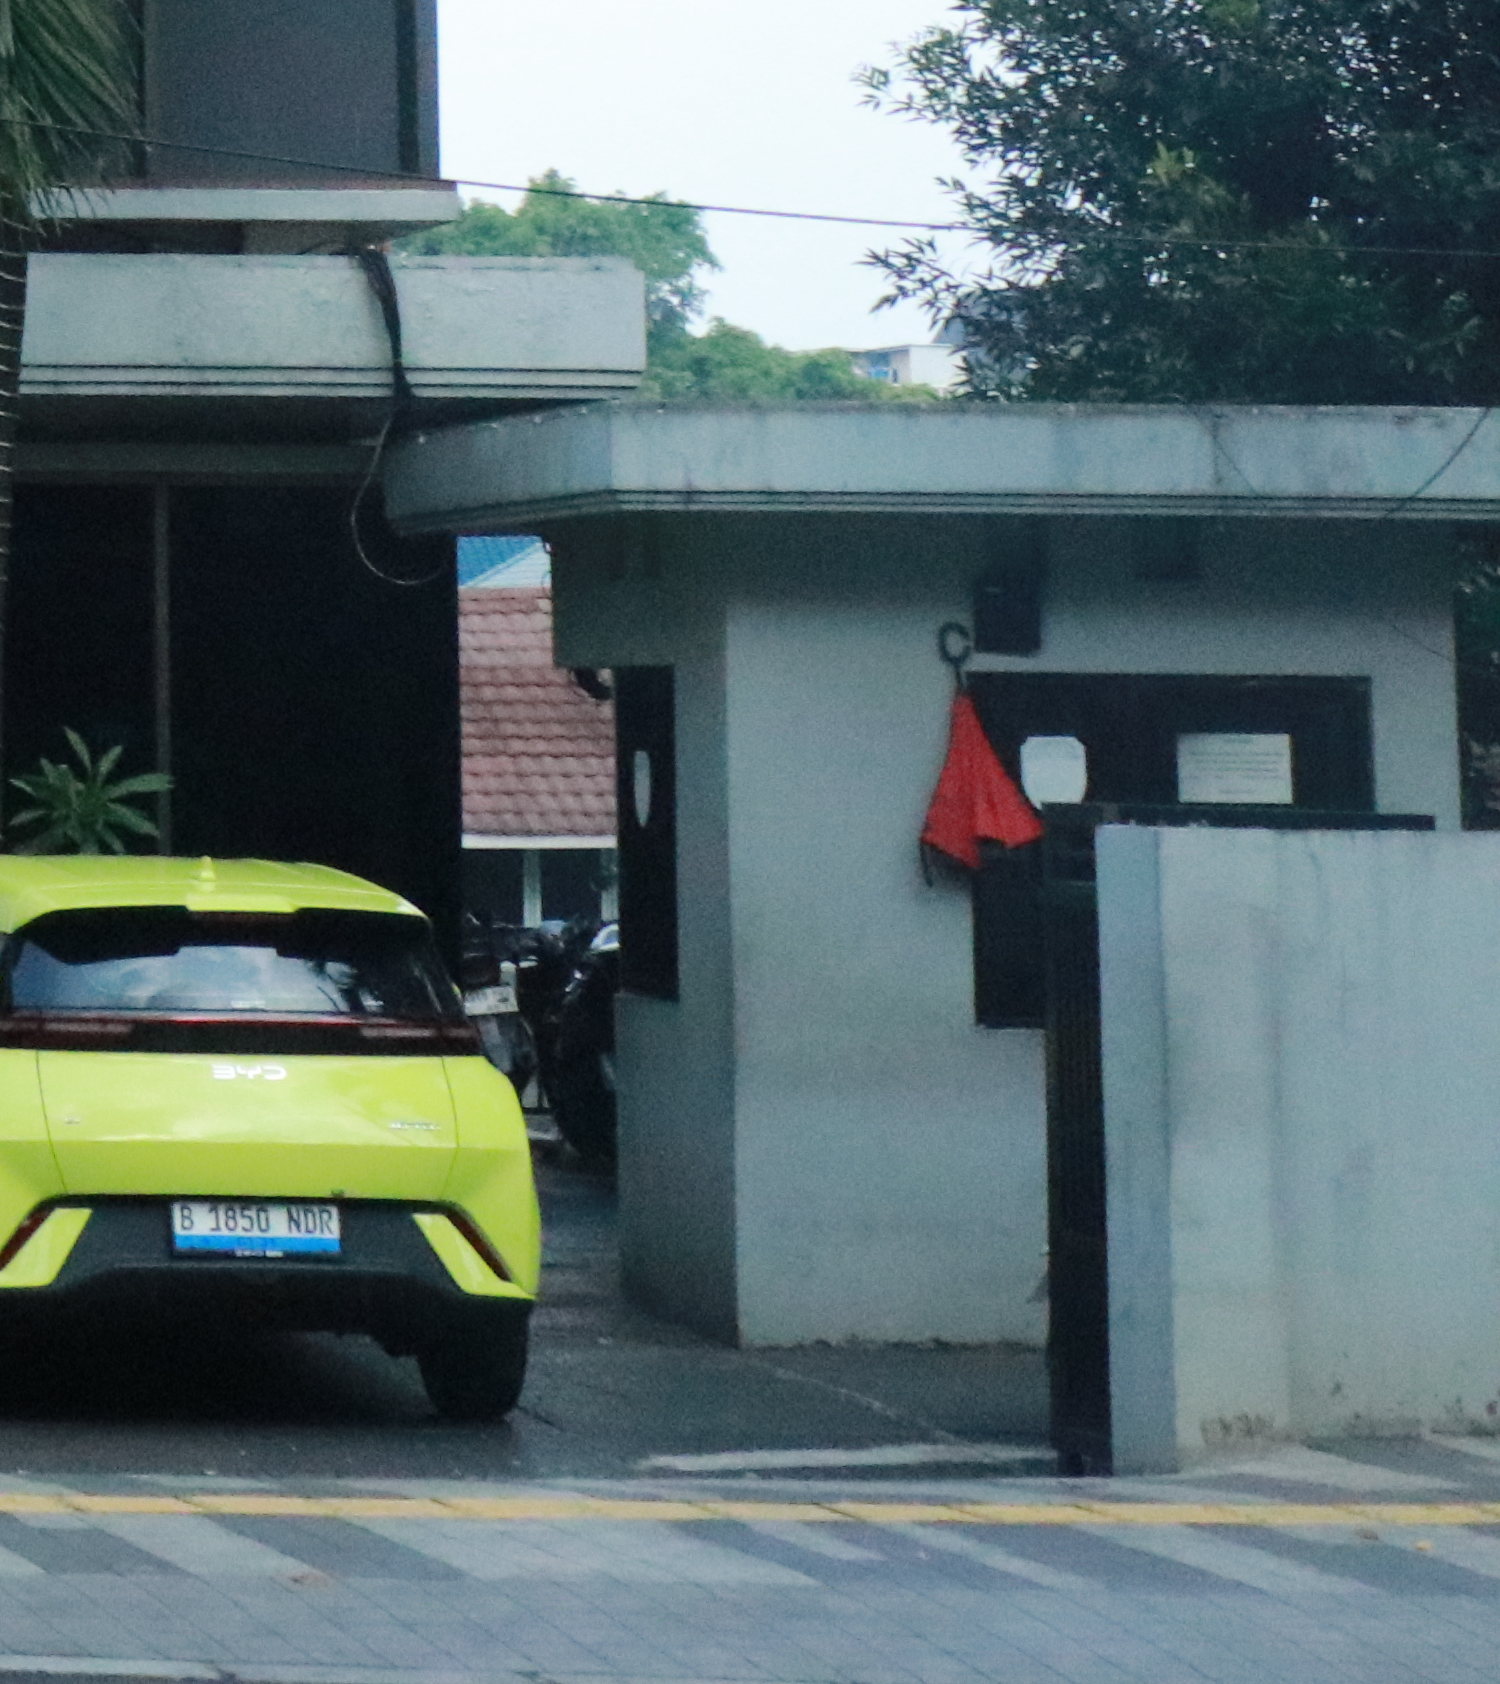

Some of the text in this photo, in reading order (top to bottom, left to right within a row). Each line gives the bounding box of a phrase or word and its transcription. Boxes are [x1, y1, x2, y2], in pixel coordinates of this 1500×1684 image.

[211, 1065, 287, 1080] BYD
[179, 1206, 335, 1236] B 1850 NDR
